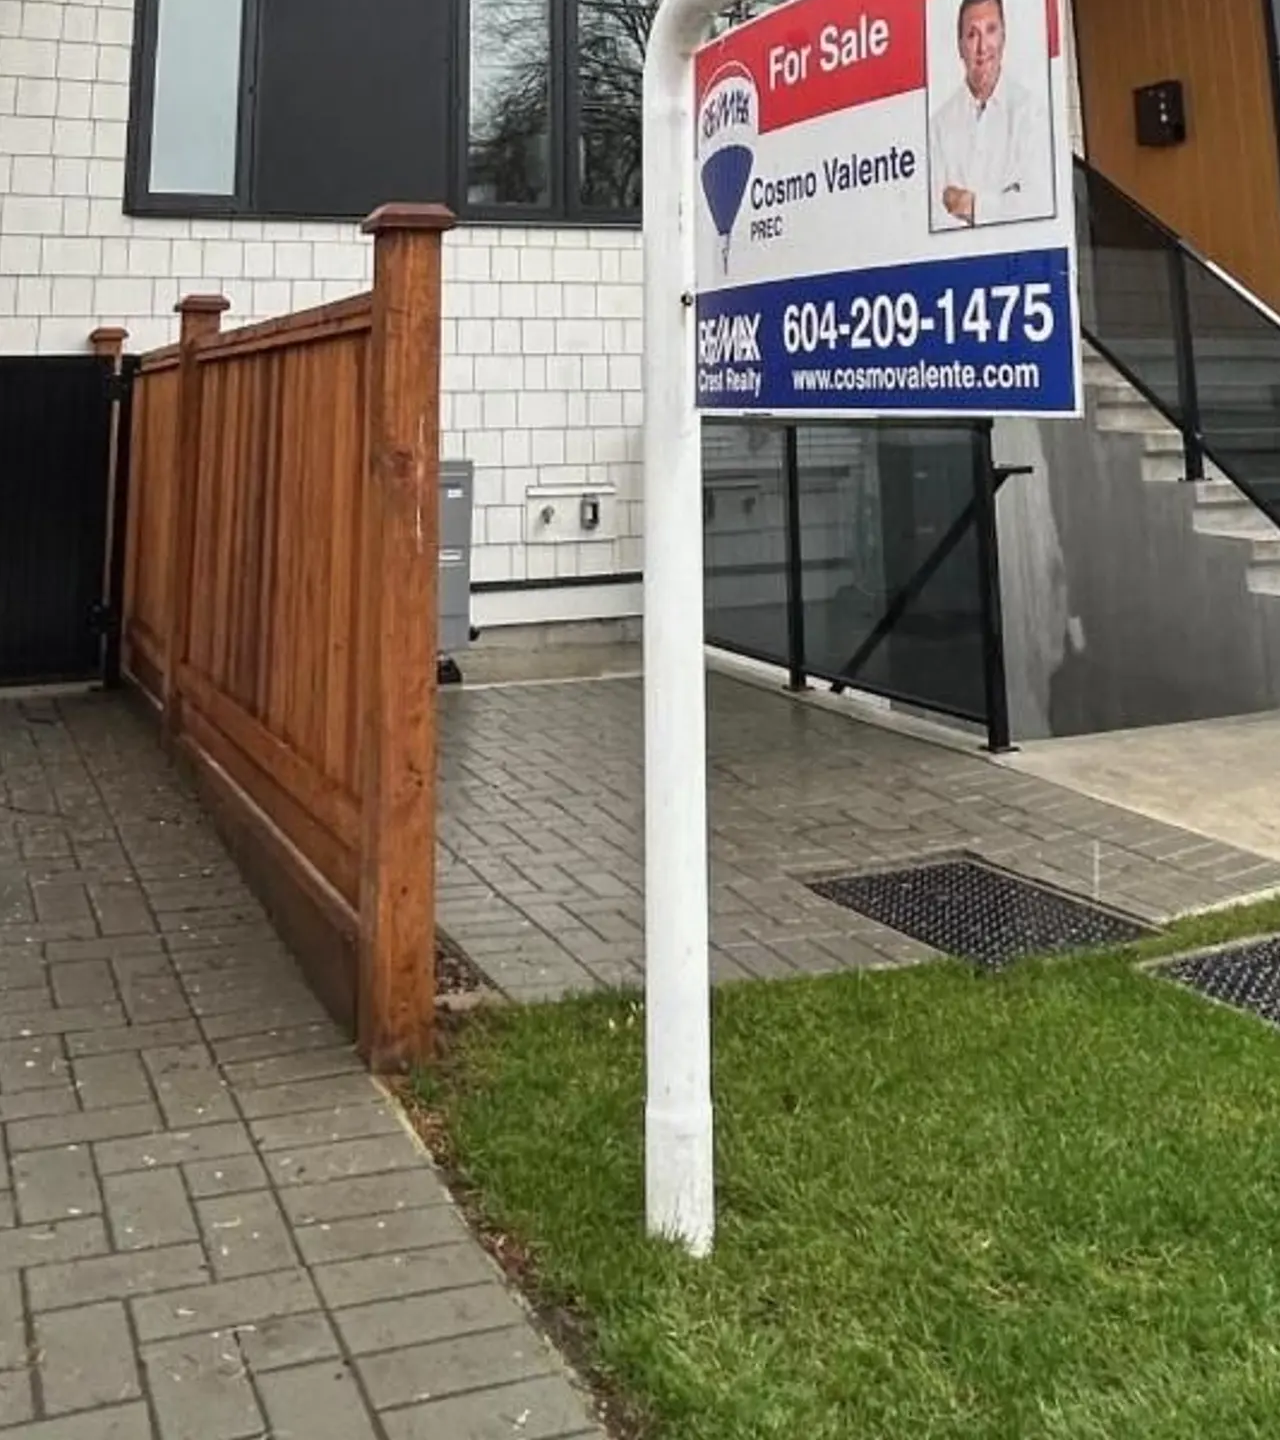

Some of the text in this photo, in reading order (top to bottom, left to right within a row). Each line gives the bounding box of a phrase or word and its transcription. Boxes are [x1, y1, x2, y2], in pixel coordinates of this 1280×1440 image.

[769, 13, 890, 91] For Sale
[749, 145, 916, 211] Cosmo Valente
[750, 216, 783, 242] PREC
[782, 282, 1055, 355] 604-209-1475
[791, 359, 1040, 392] www.cosmovalente.com
